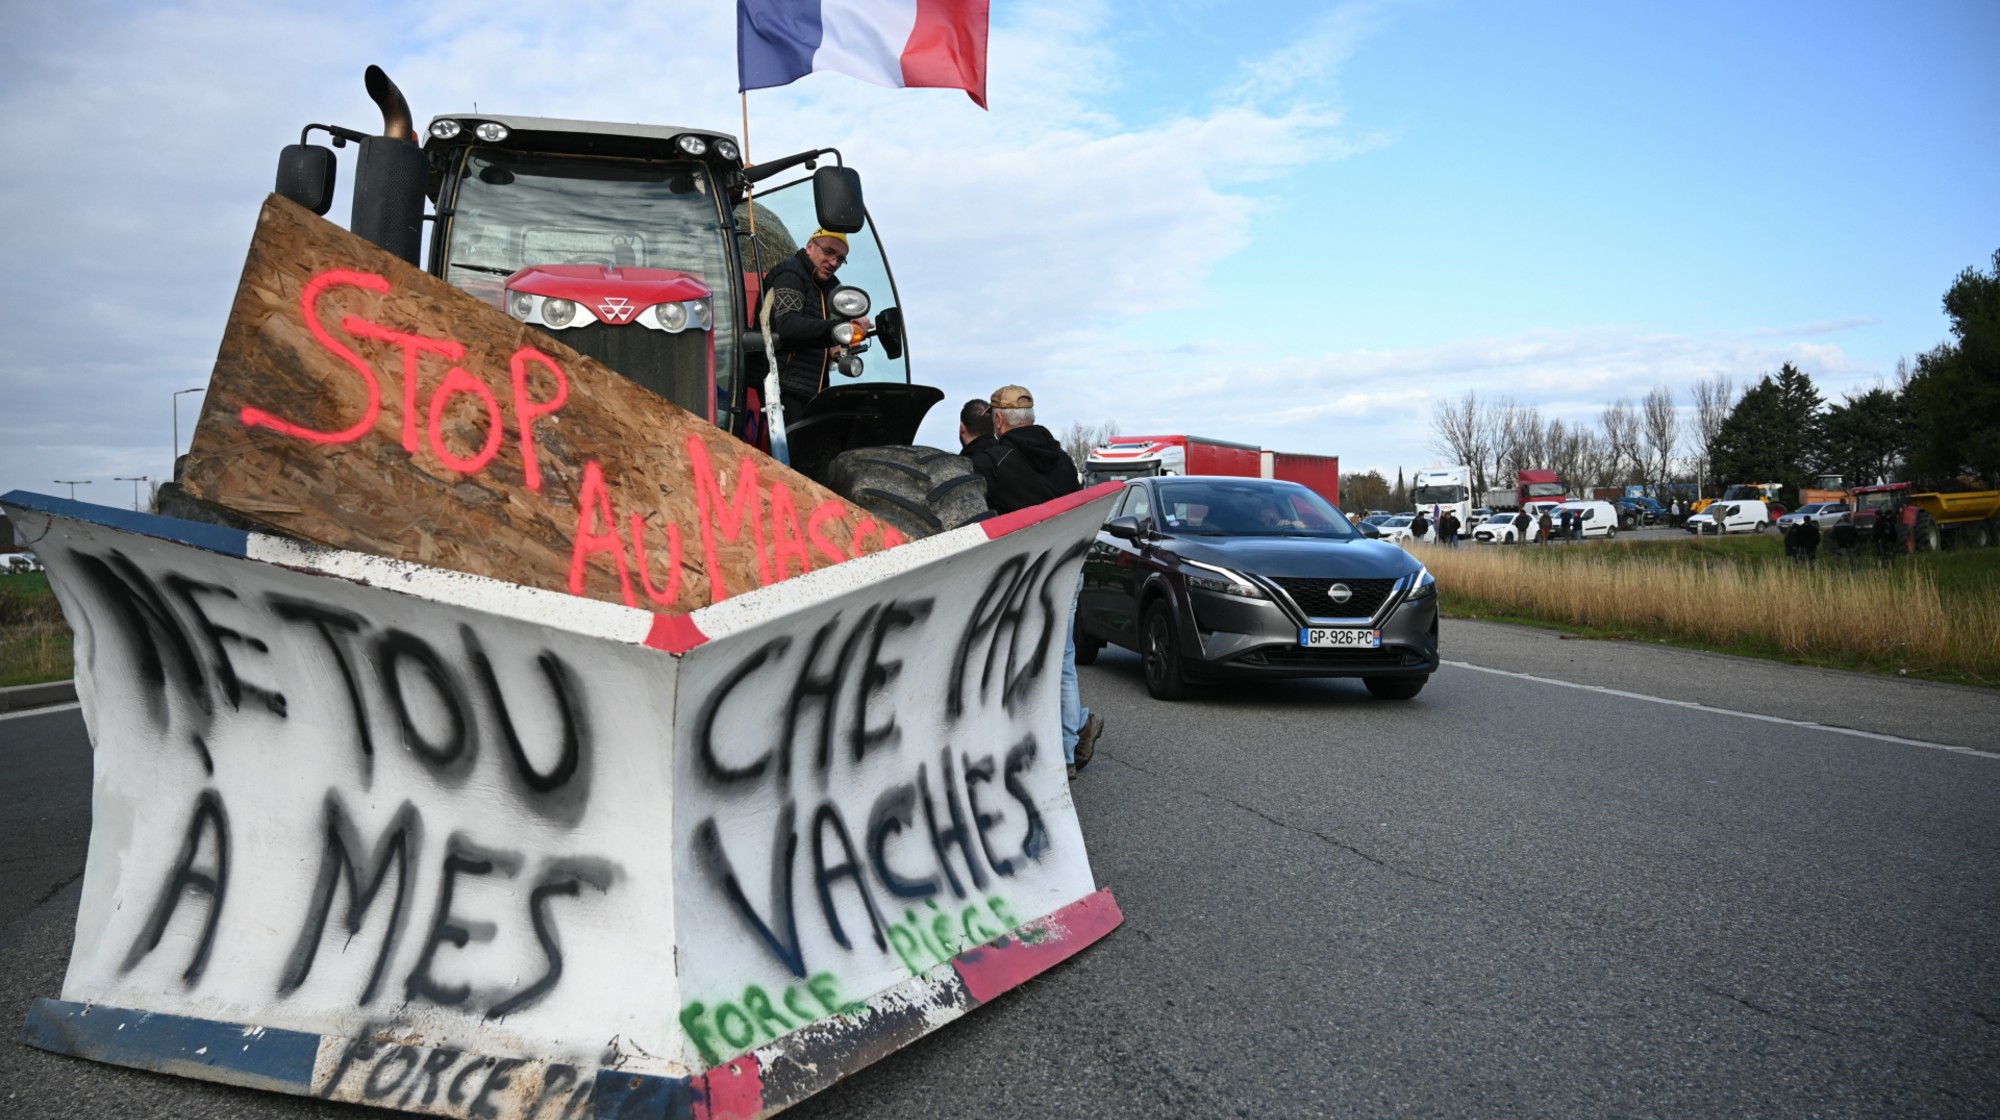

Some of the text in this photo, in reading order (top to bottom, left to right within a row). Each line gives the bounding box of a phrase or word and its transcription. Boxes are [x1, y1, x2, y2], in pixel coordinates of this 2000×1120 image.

[692, 597, 935, 795] CHE
[1310, 630, 1372, 645] GP-926-PC
[276, 788, 625, 1021] MES
[692, 734, 1050, 979] VACHES
[679, 970, 862, 1067] FORCE
